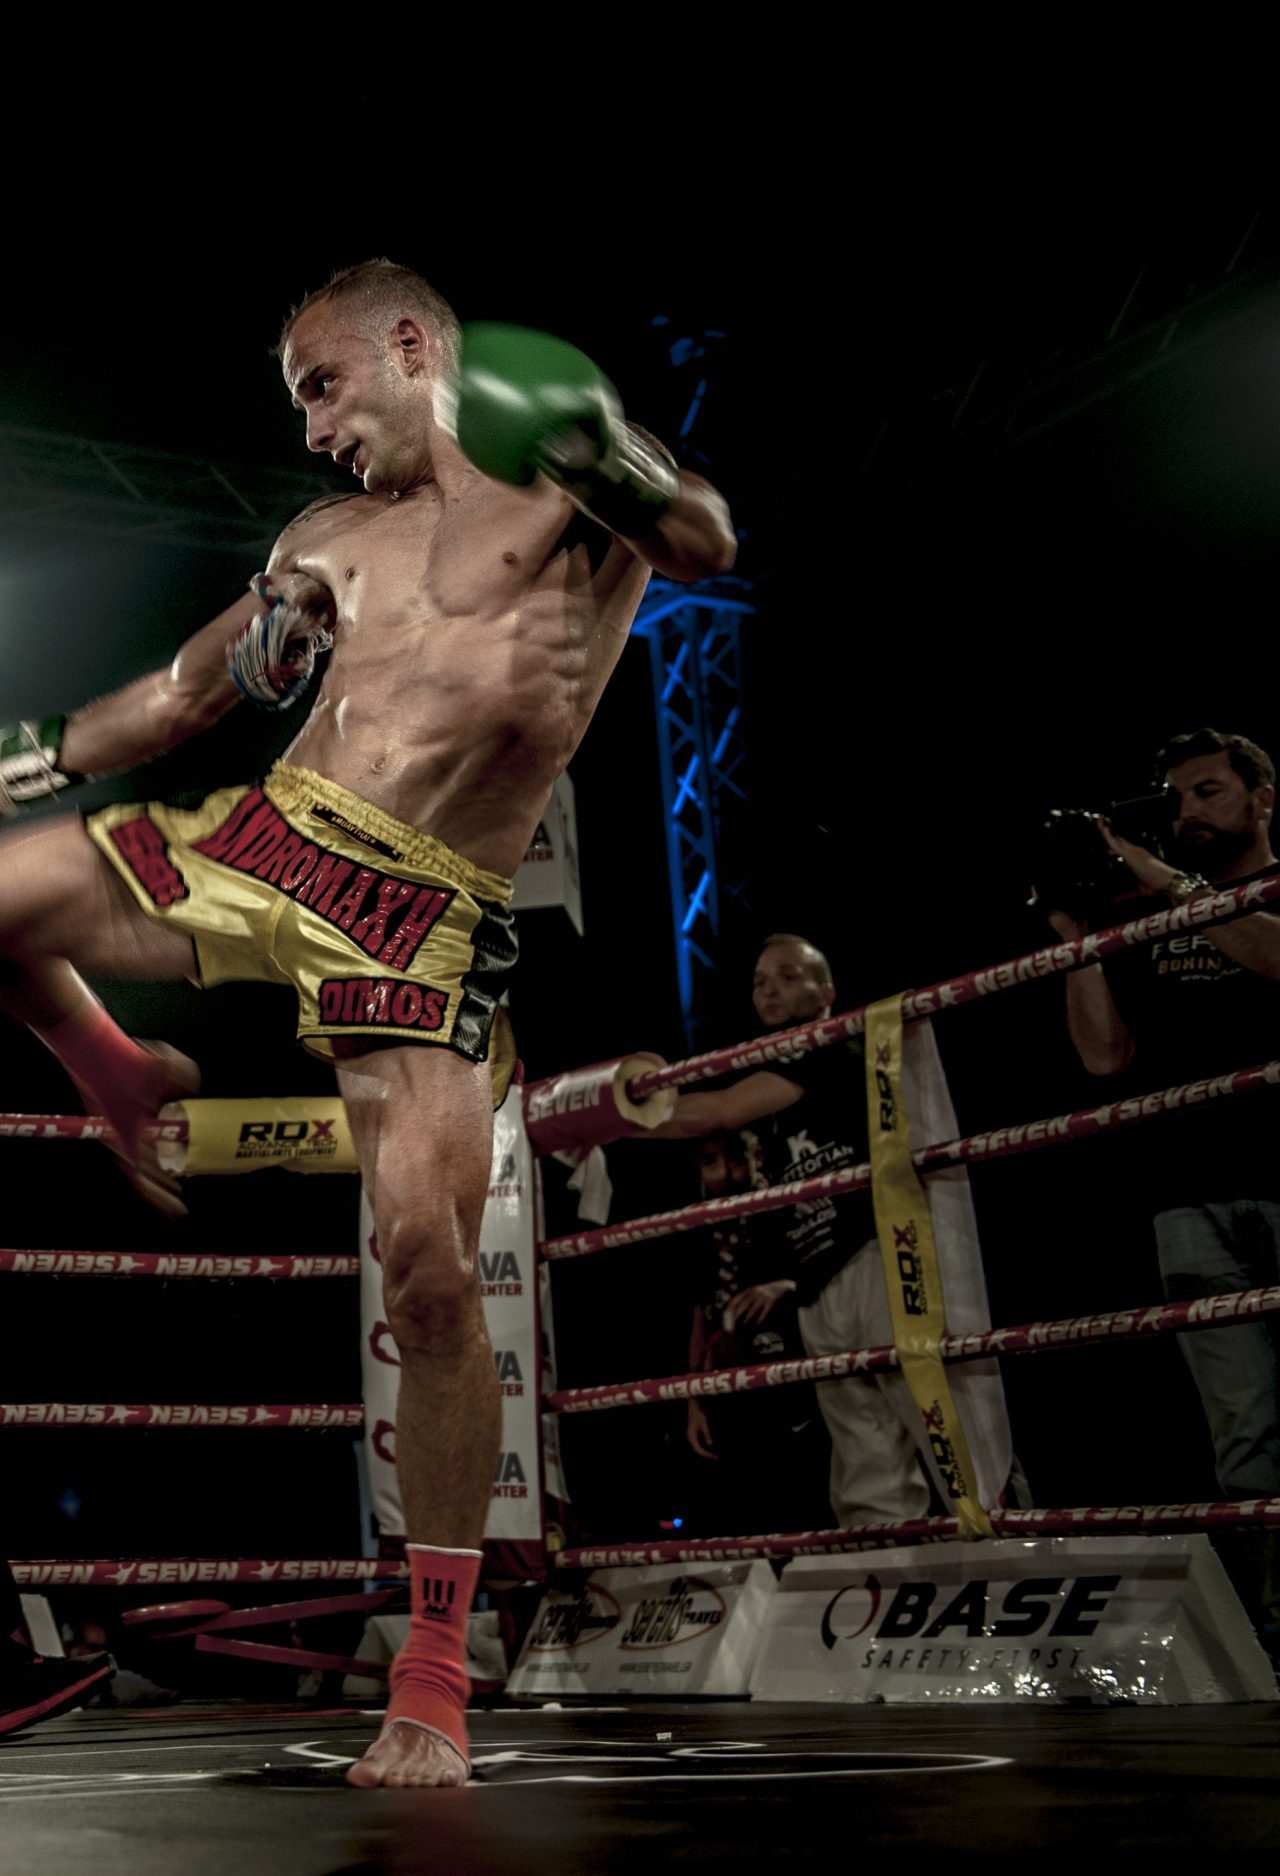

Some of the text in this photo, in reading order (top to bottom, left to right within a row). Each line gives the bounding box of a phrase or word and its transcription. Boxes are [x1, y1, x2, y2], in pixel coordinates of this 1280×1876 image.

[1122, 887, 1238, 945] SEVEN
[974, 941, 1076, 996] SEVEN
[321, 979, 449, 1029] DIMOS
[528, 1078, 601, 1123] SEVEN
[968, 1072, 1239, 1156] SEVEN SEVEN
[487, 1184, 522, 1198] NTER
[14, 1251, 116, 1273] SEVEN
[156, 1256, 253, 1278] SEVEN
[291, 1255, 359, 1277] EVEN
[480, 1283, 523, 1296] ENTER
[659, 1371, 732, 1400] SEVEN
[765, 1354, 852, 1385] SEVEN
[1027, 1309, 1134, 1346] SEVEN
[4, 1404, 106, 1426] SEVEN
[149, 1405, 249, 1427] SEVEN
[288, 1406, 364, 1428] EVEN
[492, 1485, 527, 1498] NTER
[11, 1564, 94, 1585] EVEN
[135, 1562, 240, 1584] SEVEN
[280, 1560, 377, 1581] SEVEN
[876, 1575, 1122, 1638] BASE
[861, 1647, 1084, 1669] SAFETY FIRST
